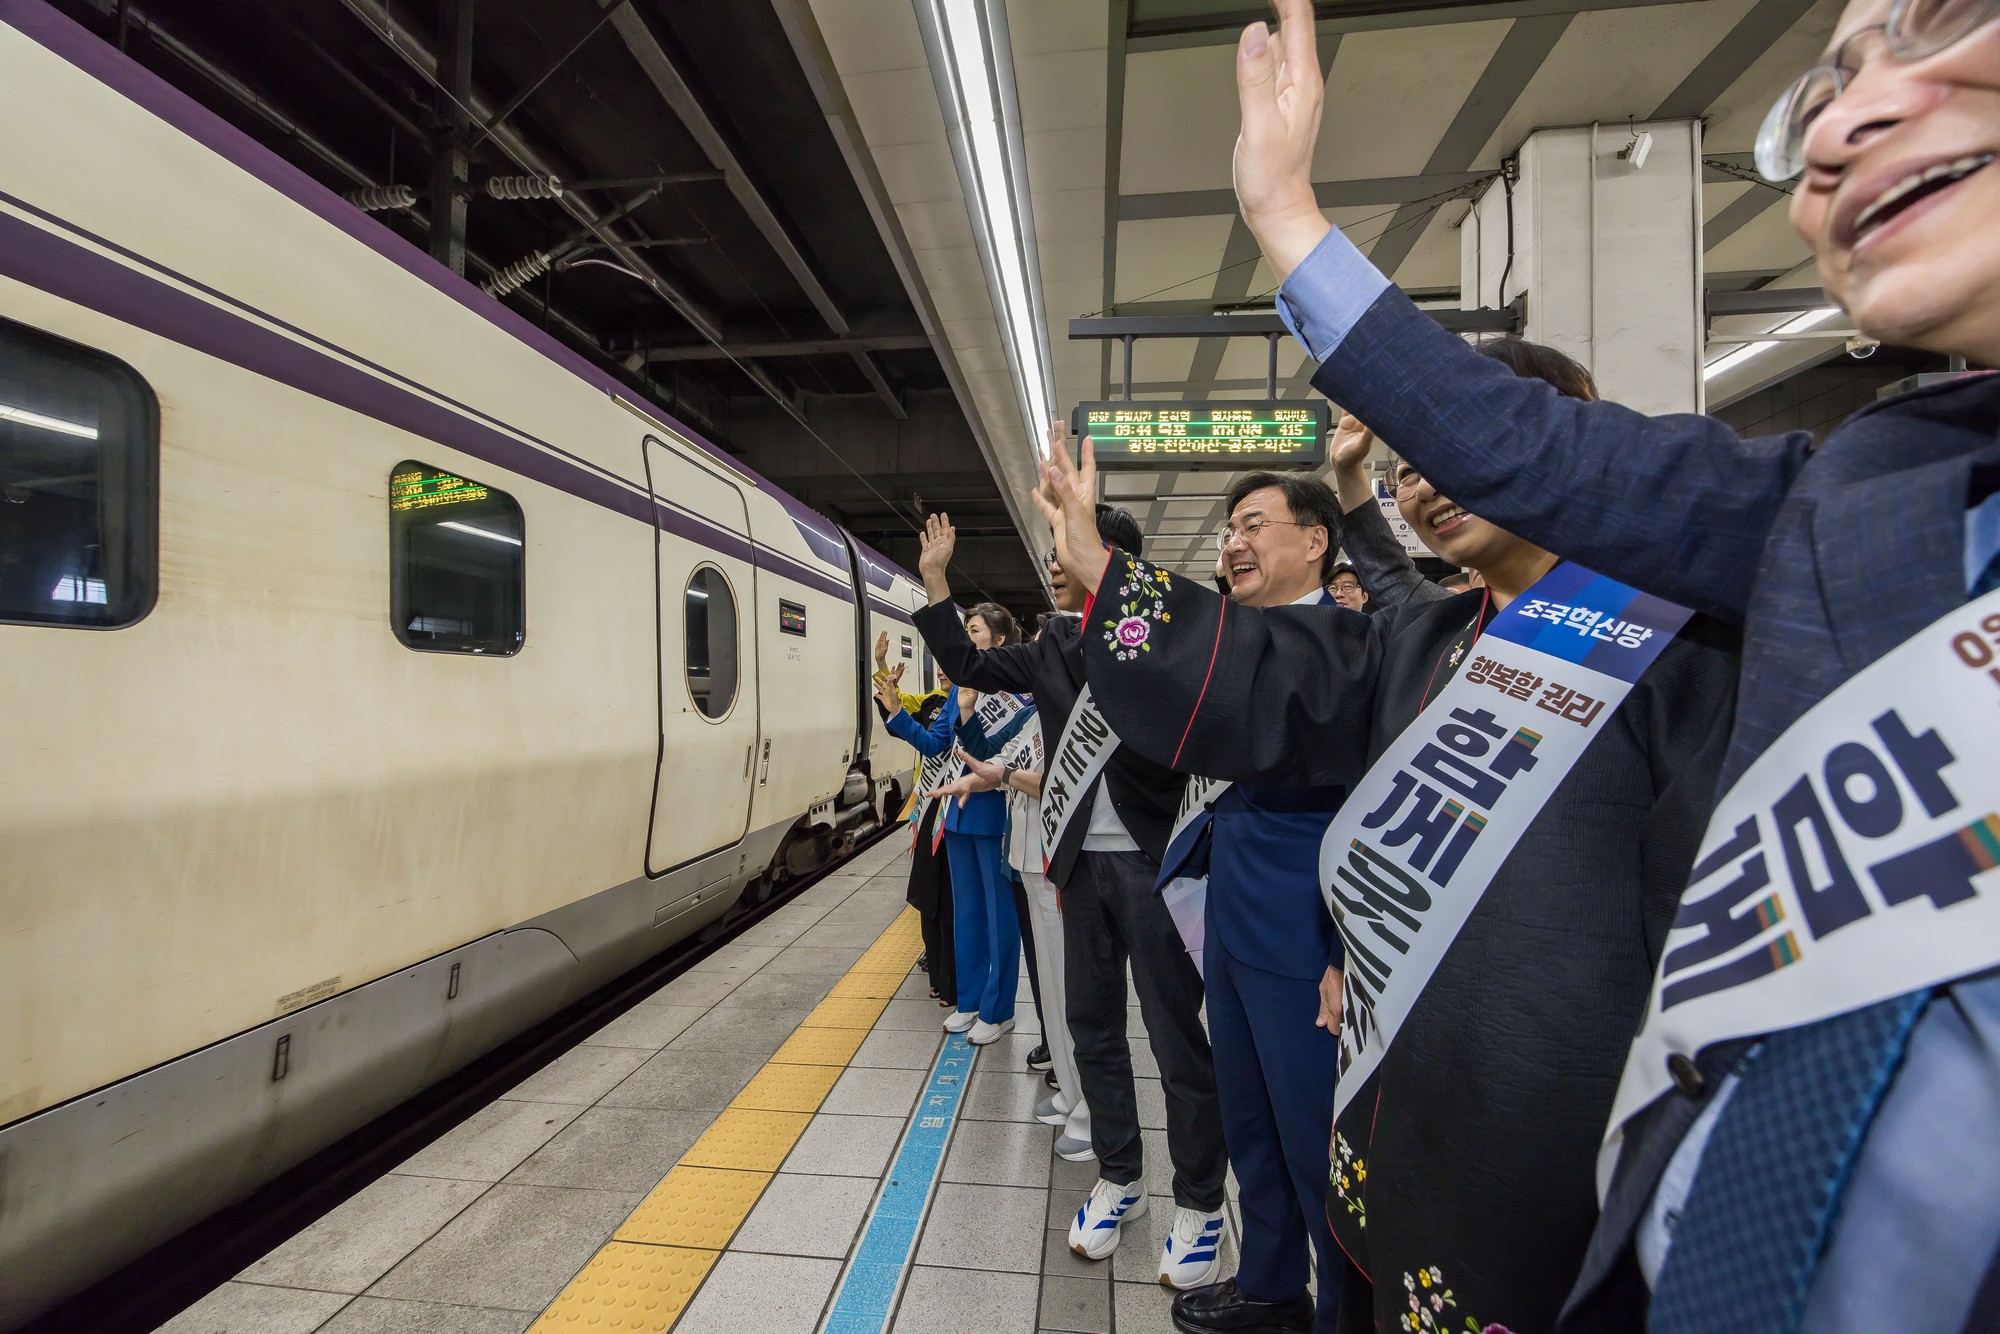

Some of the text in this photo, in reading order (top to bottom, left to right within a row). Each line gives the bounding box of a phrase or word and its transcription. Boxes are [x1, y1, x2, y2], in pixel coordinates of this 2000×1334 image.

[1115, 424, 1152, 436] 09:44
[1158, 424, 1187, 436] 목포
[1212, 424, 1235, 436] KTX
[1279, 424, 1304, 436] 415
[1517, 600, 1653, 649] 조국혁신당
[1465, 655, 1606, 728] 행복할 권리
[1361, 706, 1540, 889] 함께
[919, 1040, 970, 1129] 열차대기선
